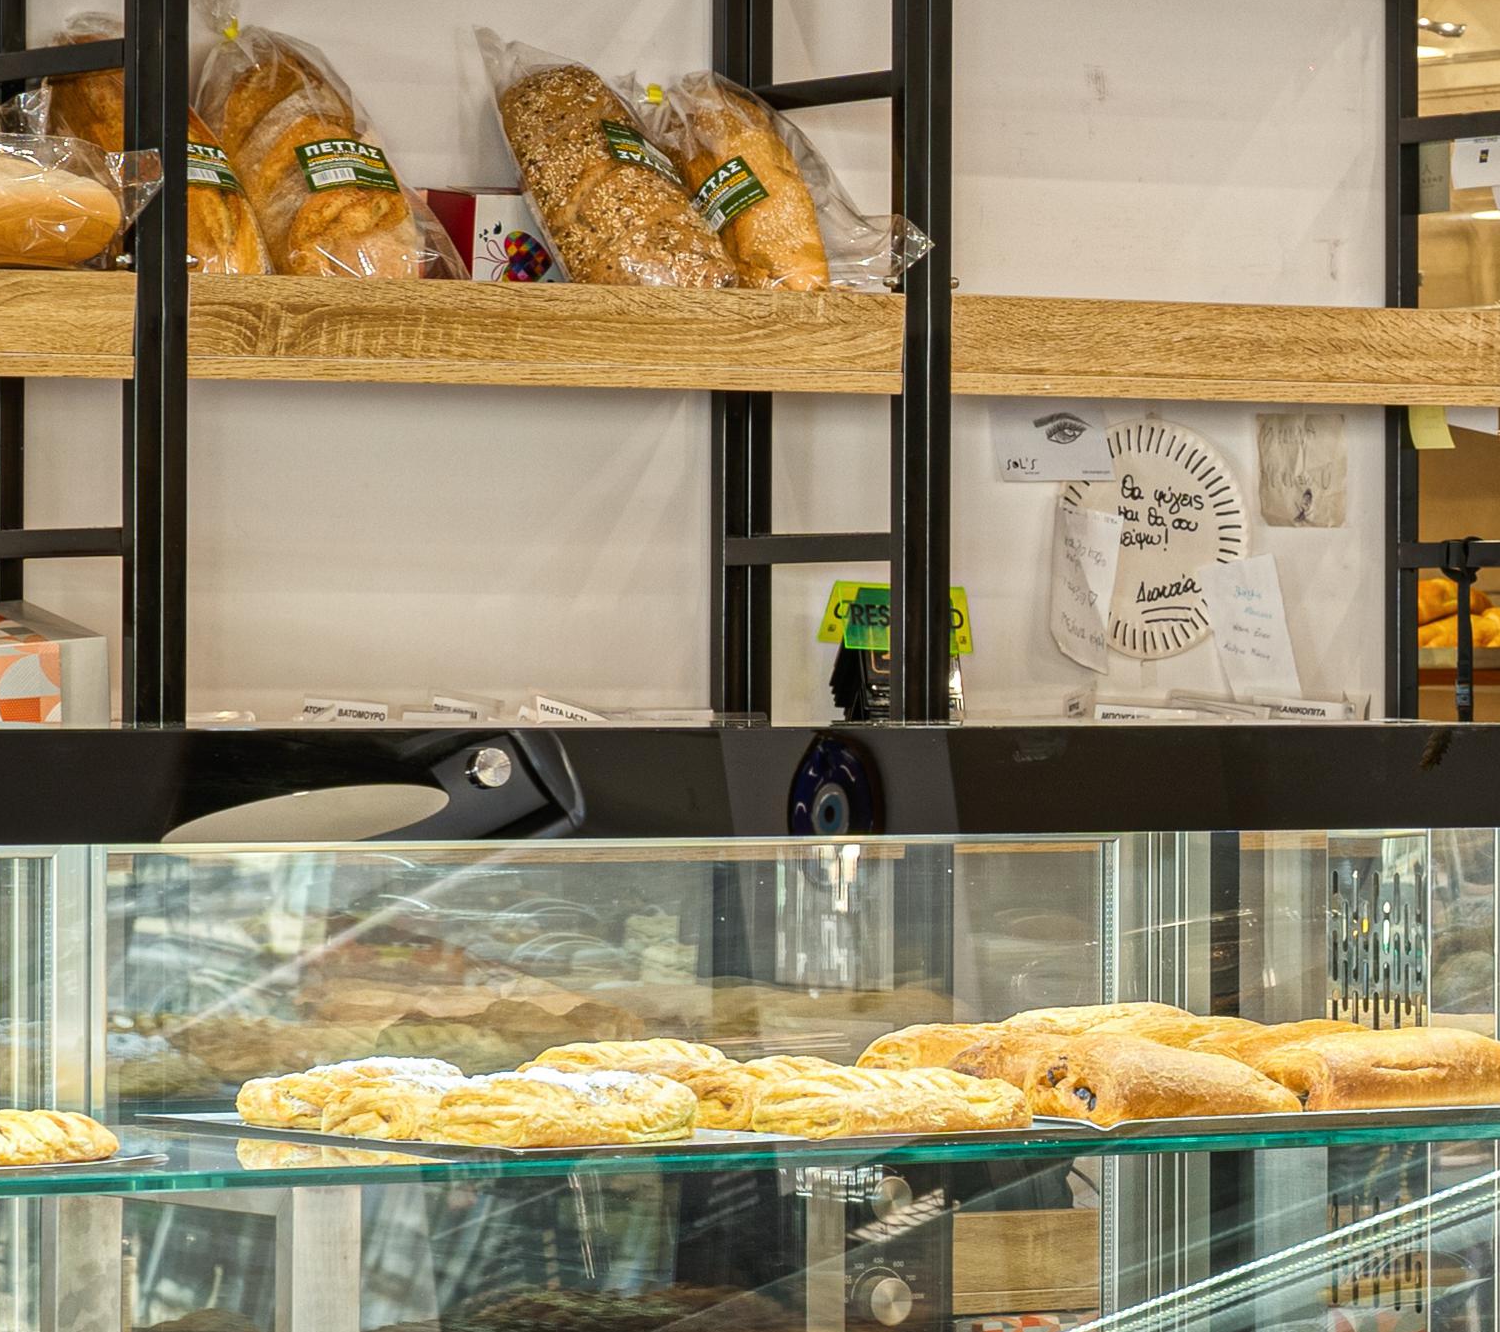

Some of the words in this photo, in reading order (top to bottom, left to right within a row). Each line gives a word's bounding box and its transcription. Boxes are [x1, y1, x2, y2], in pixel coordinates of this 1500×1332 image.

[188, 143, 228, 160] ΕΤΤΑ
[304, 141, 381, 159] ΠΕΤΤΑΣ
[1120, 528, 1169, 551] είψω!
[337, 708, 386, 722] ΒΑΤΟΜΟΥΡΟ
[540, 703, 564, 716] ΠΑΣΤΑ
